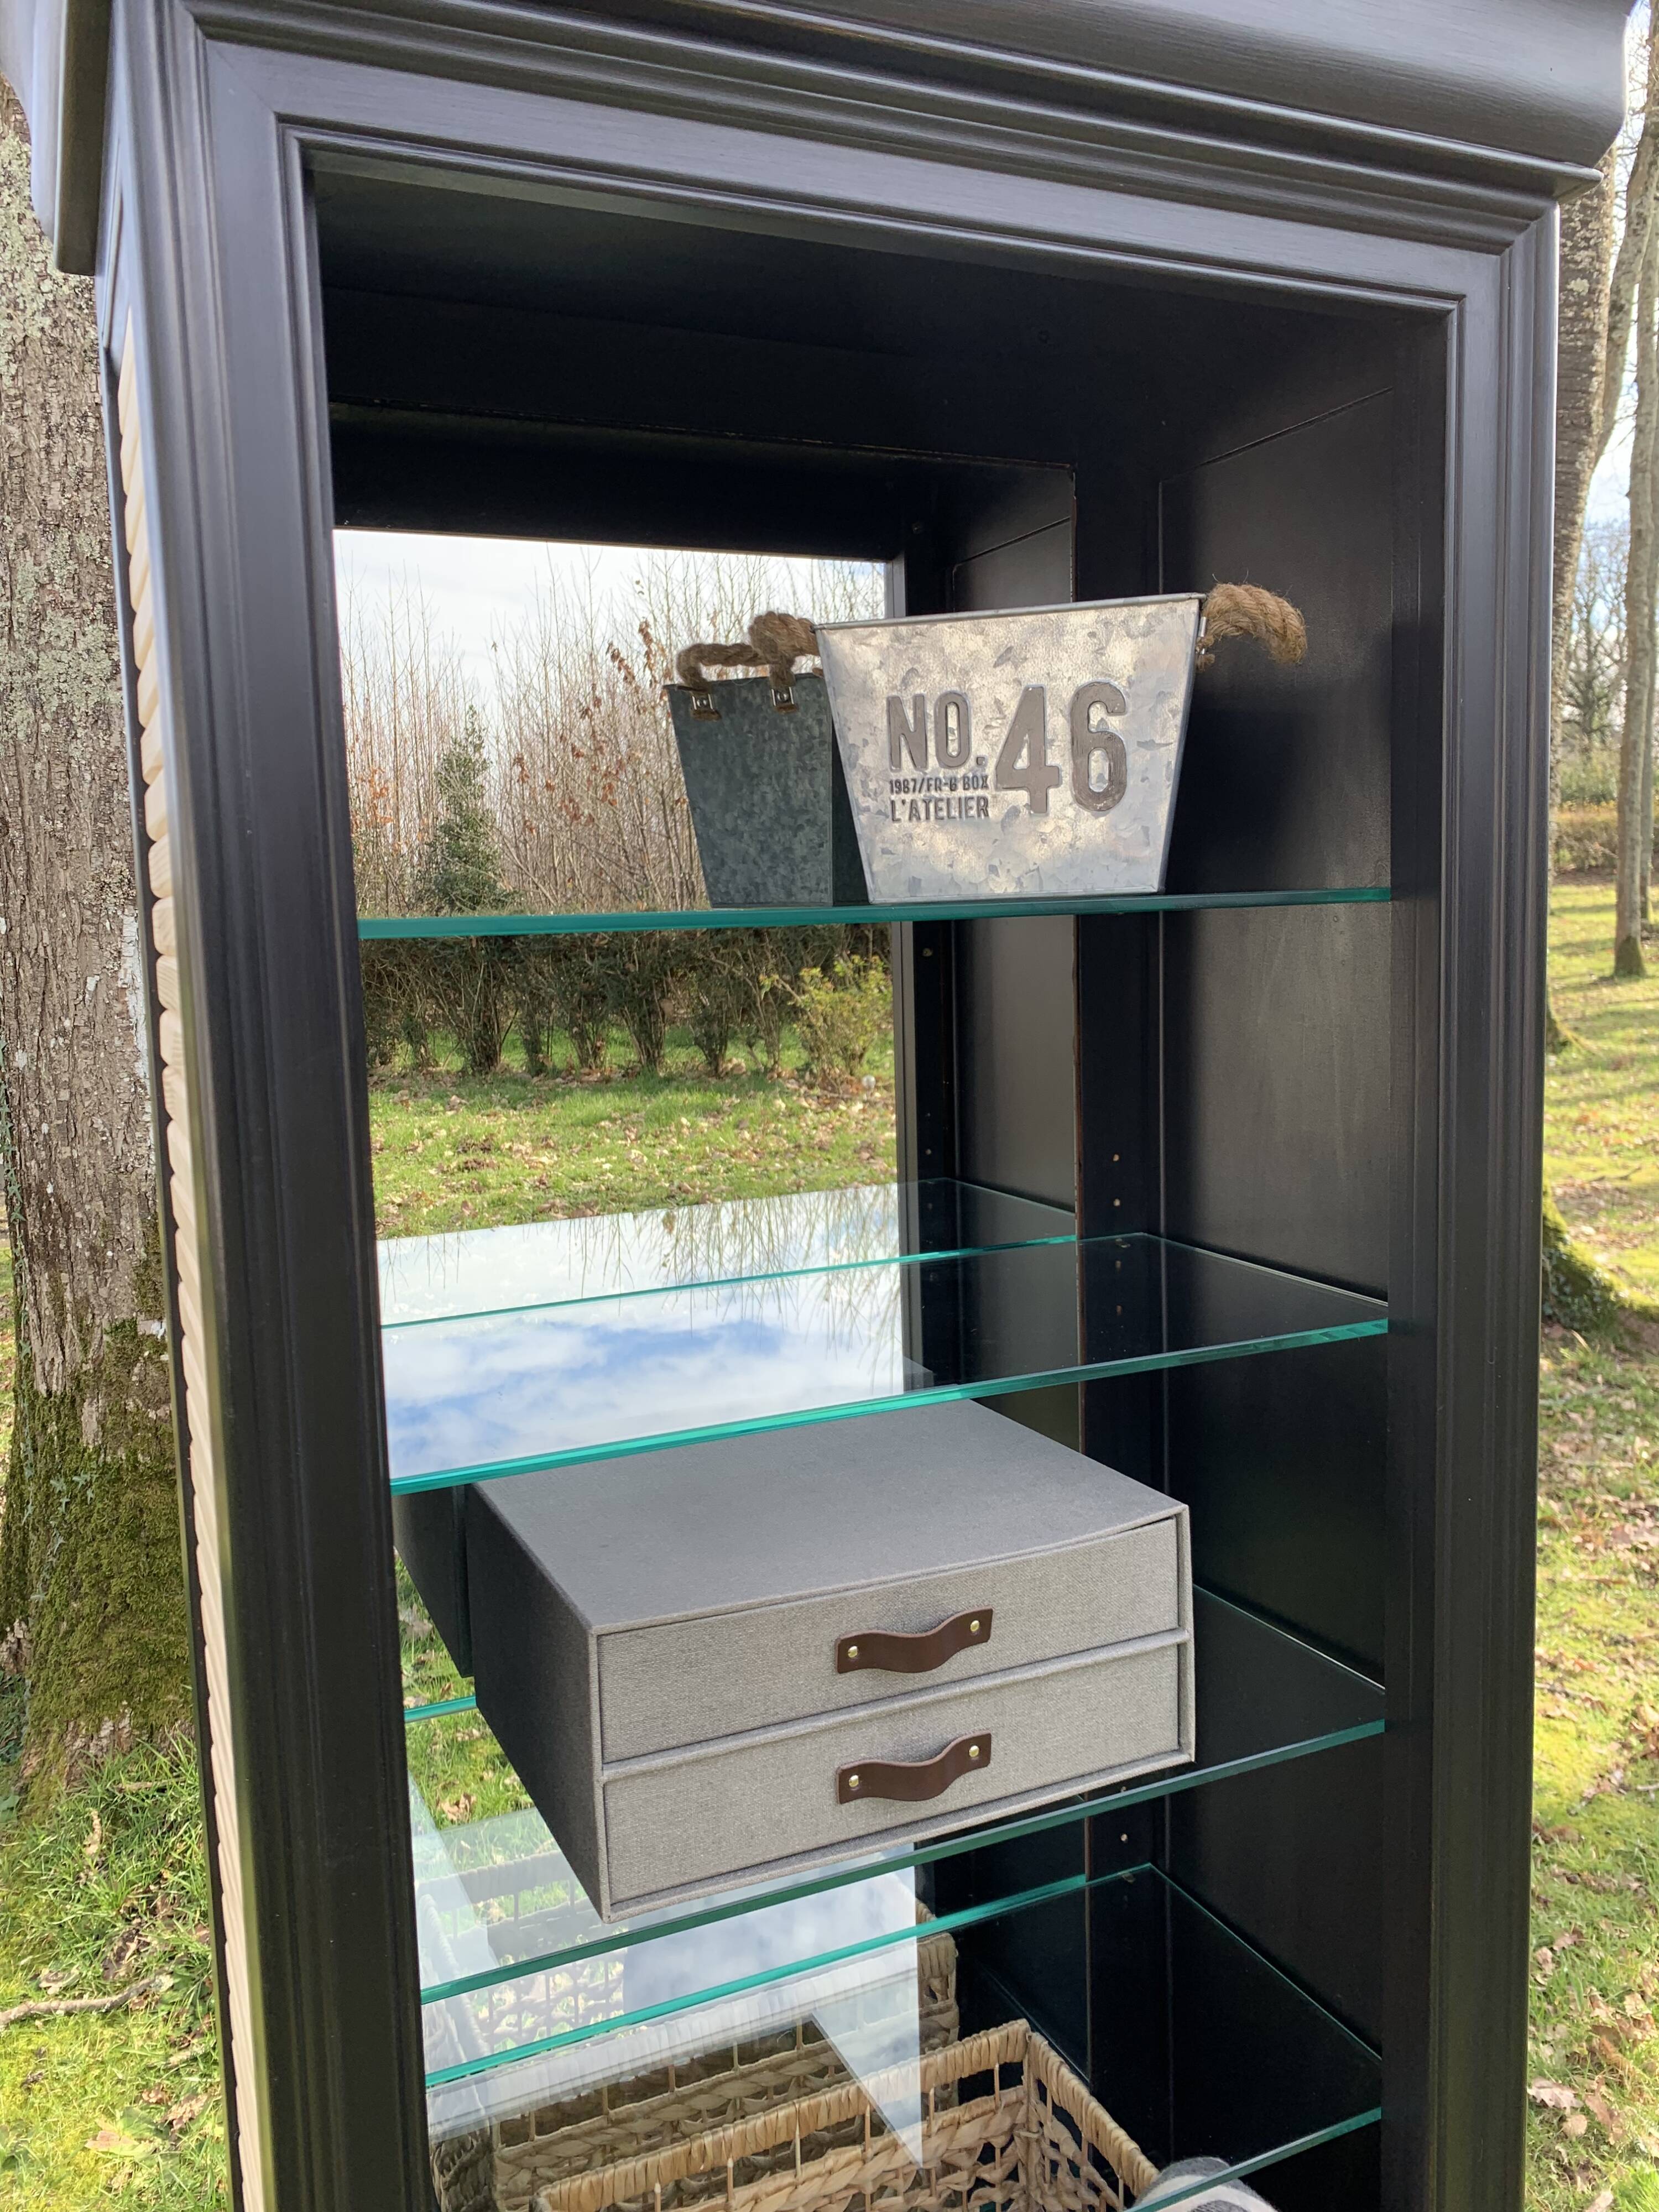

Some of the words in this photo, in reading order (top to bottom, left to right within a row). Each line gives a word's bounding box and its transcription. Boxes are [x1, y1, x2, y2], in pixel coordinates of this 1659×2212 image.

[888, 691, 987, 770] NO.
[996, 682, 1127, 813] 46
[962, 775, 989, 791] BOX
[890, 796, 989, 822] L'ATELIER
